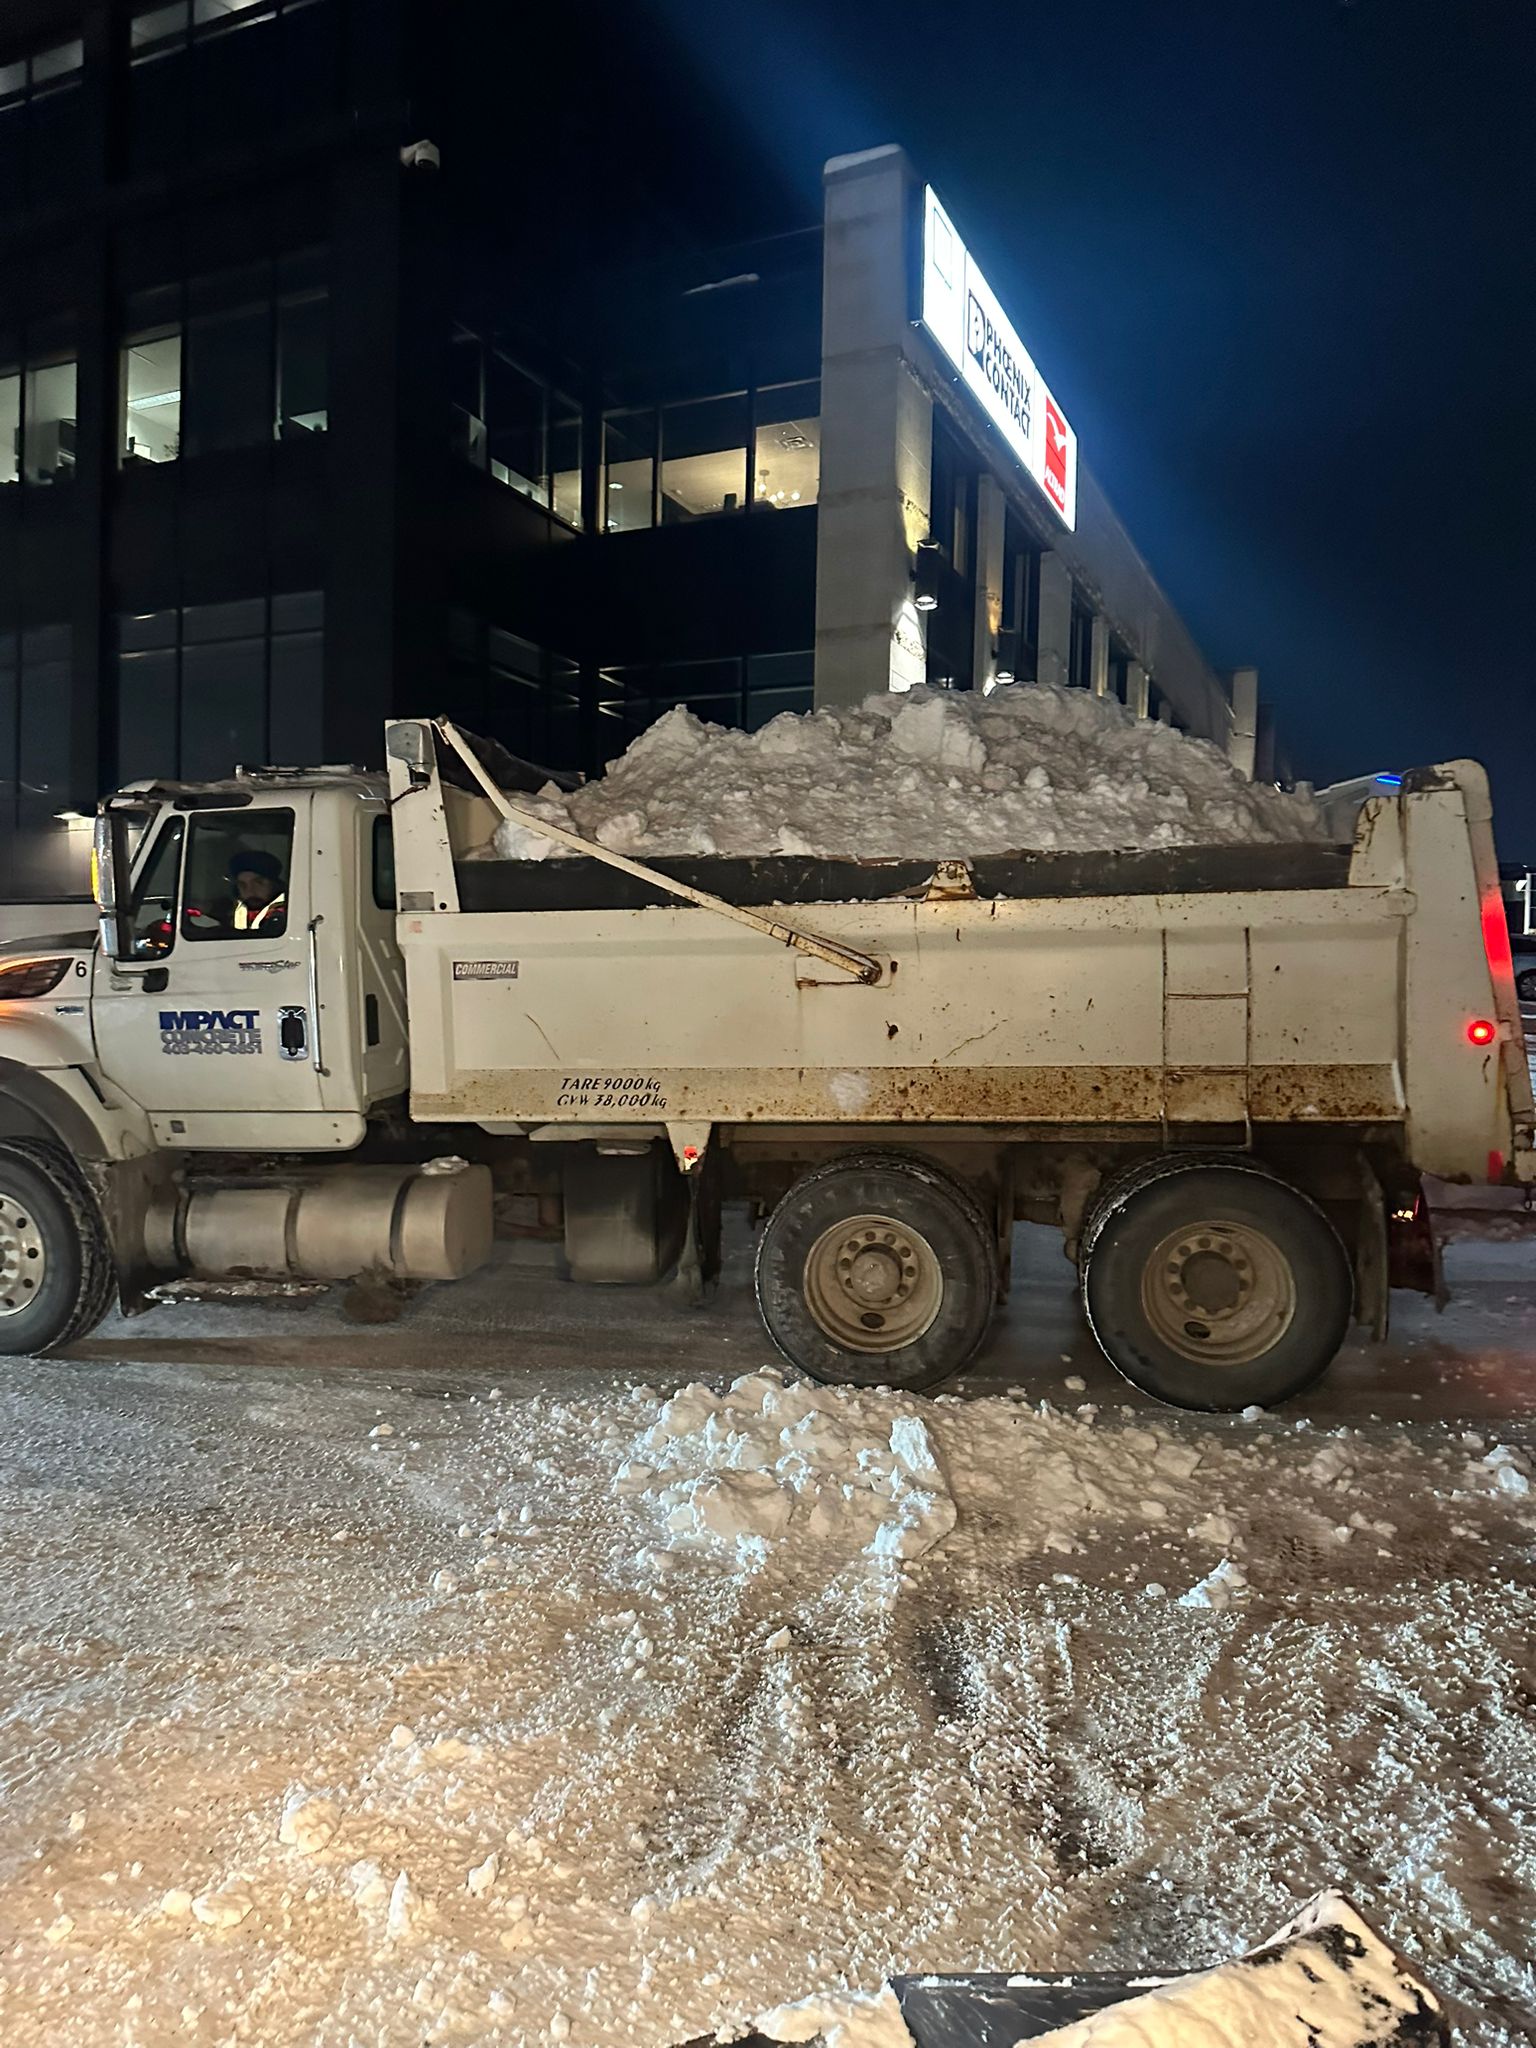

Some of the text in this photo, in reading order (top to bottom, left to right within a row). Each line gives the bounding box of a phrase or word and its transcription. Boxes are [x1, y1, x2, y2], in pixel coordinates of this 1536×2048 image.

[985, 351, 1031, 440] CONTACT
[75, 960, 87, 978] 6
[455, 963, 517, 975] COMMERCIAL
[159, 1010, 260, 1030] IMPACT
[160, 1029, 262, 1044] CONCRETE
[561, 1077, 602, 1090] TARE
